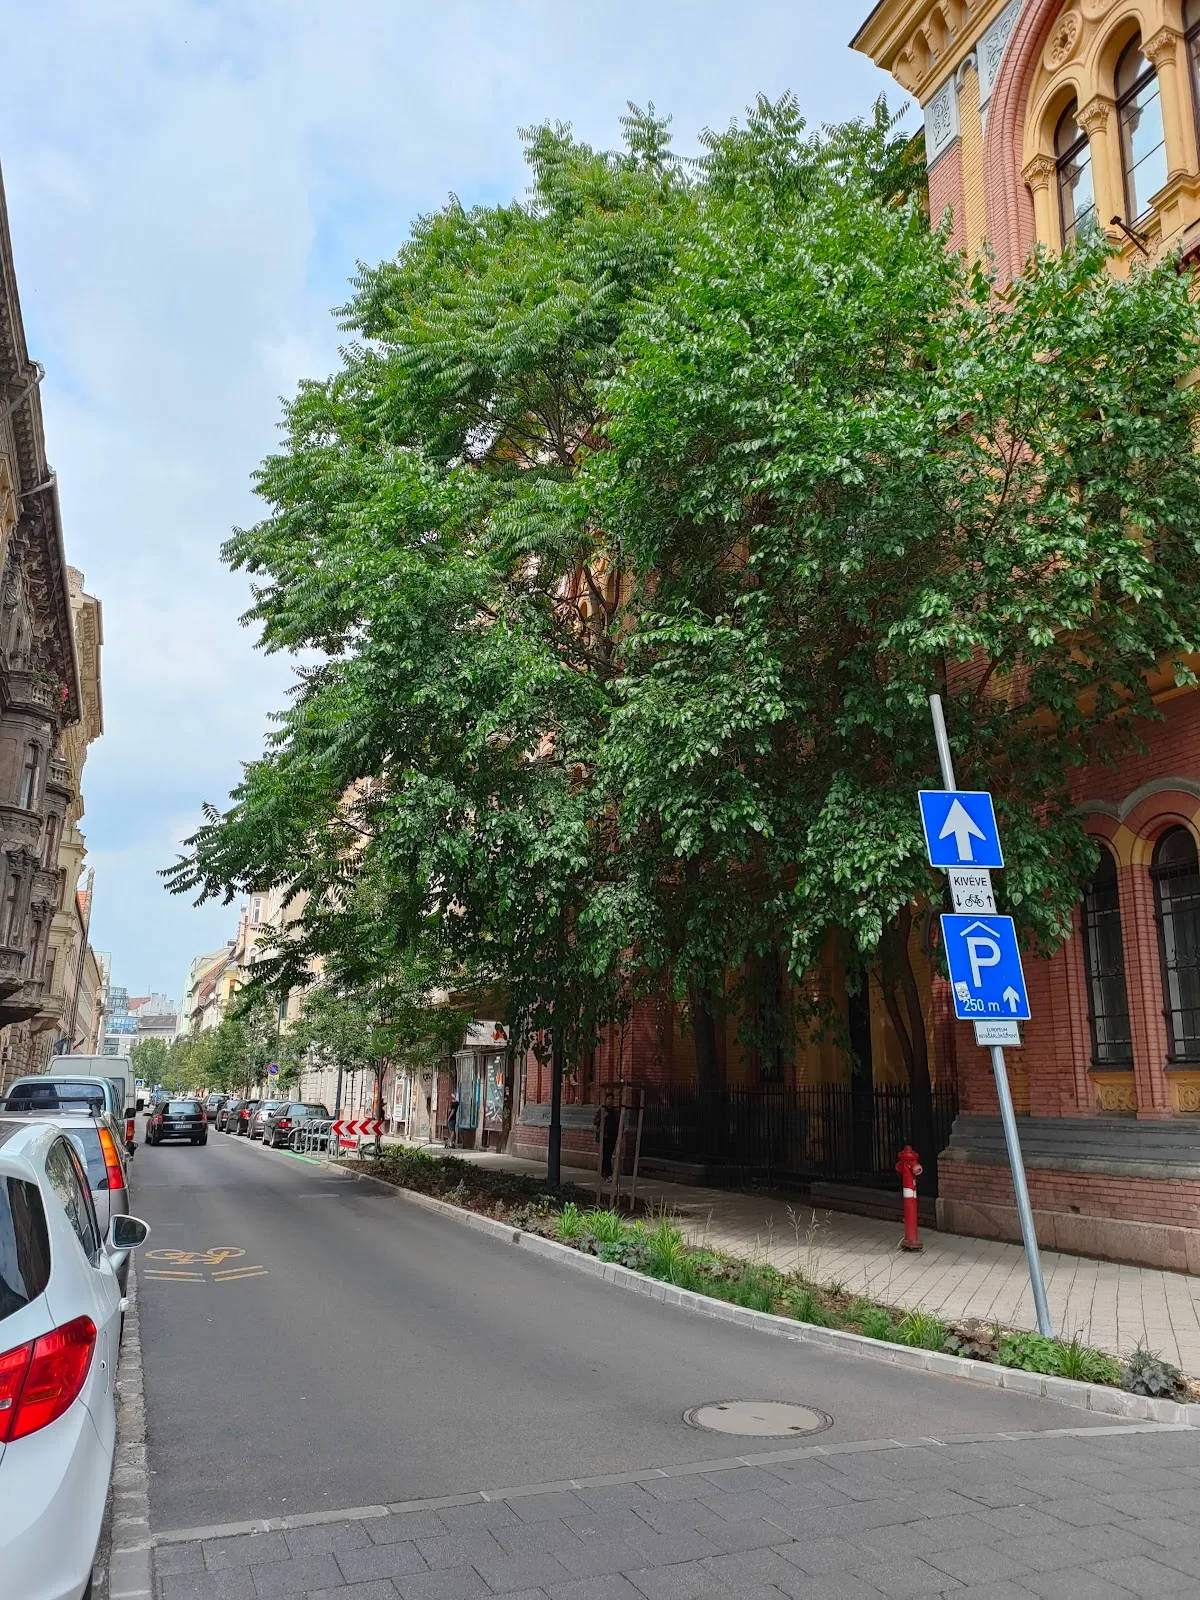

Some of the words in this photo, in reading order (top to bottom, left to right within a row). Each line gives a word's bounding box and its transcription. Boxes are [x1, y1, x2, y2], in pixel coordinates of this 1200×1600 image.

[953, 875, 988, 887] KIVÉVE
[967, 937, 1001, 988] P
[963, 998, 985, 1012] 250
[988, 1002, 1001, 1012] m
